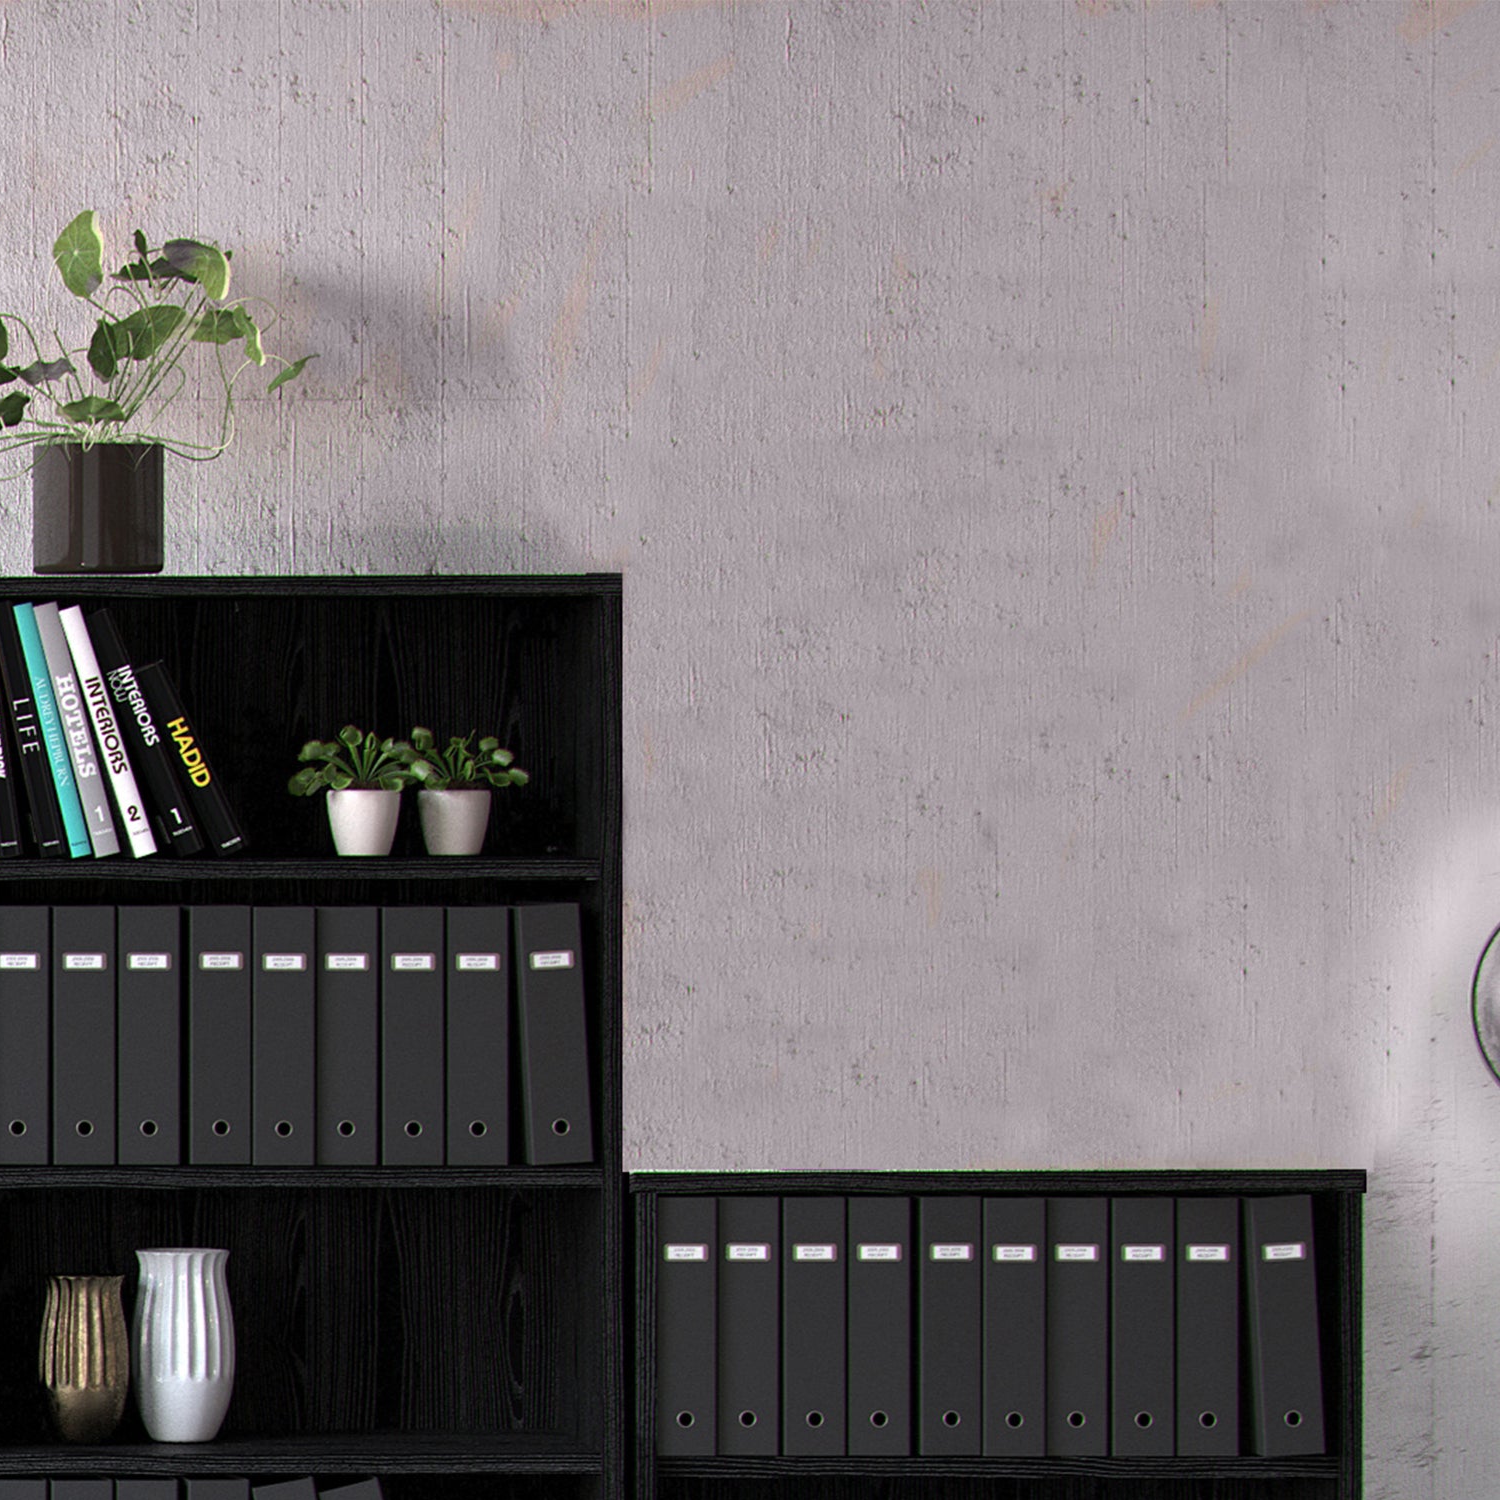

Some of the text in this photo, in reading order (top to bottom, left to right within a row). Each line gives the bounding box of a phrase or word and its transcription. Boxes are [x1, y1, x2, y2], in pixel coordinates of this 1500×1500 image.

[107, 670, 129, 703] NOW
[116, 664, 160, 748] INTERIORS
[13, 697, 40, 755] LIFE
[55, 673, 96, 778] HOTELS
[85, 676, 128, 775] INTERIORS
[166, 716, 211, 788] HADID
[94, 805, 105, 822] 1
[127, 805, 141, 822] 2
[170, 807, 182, 824] 1
